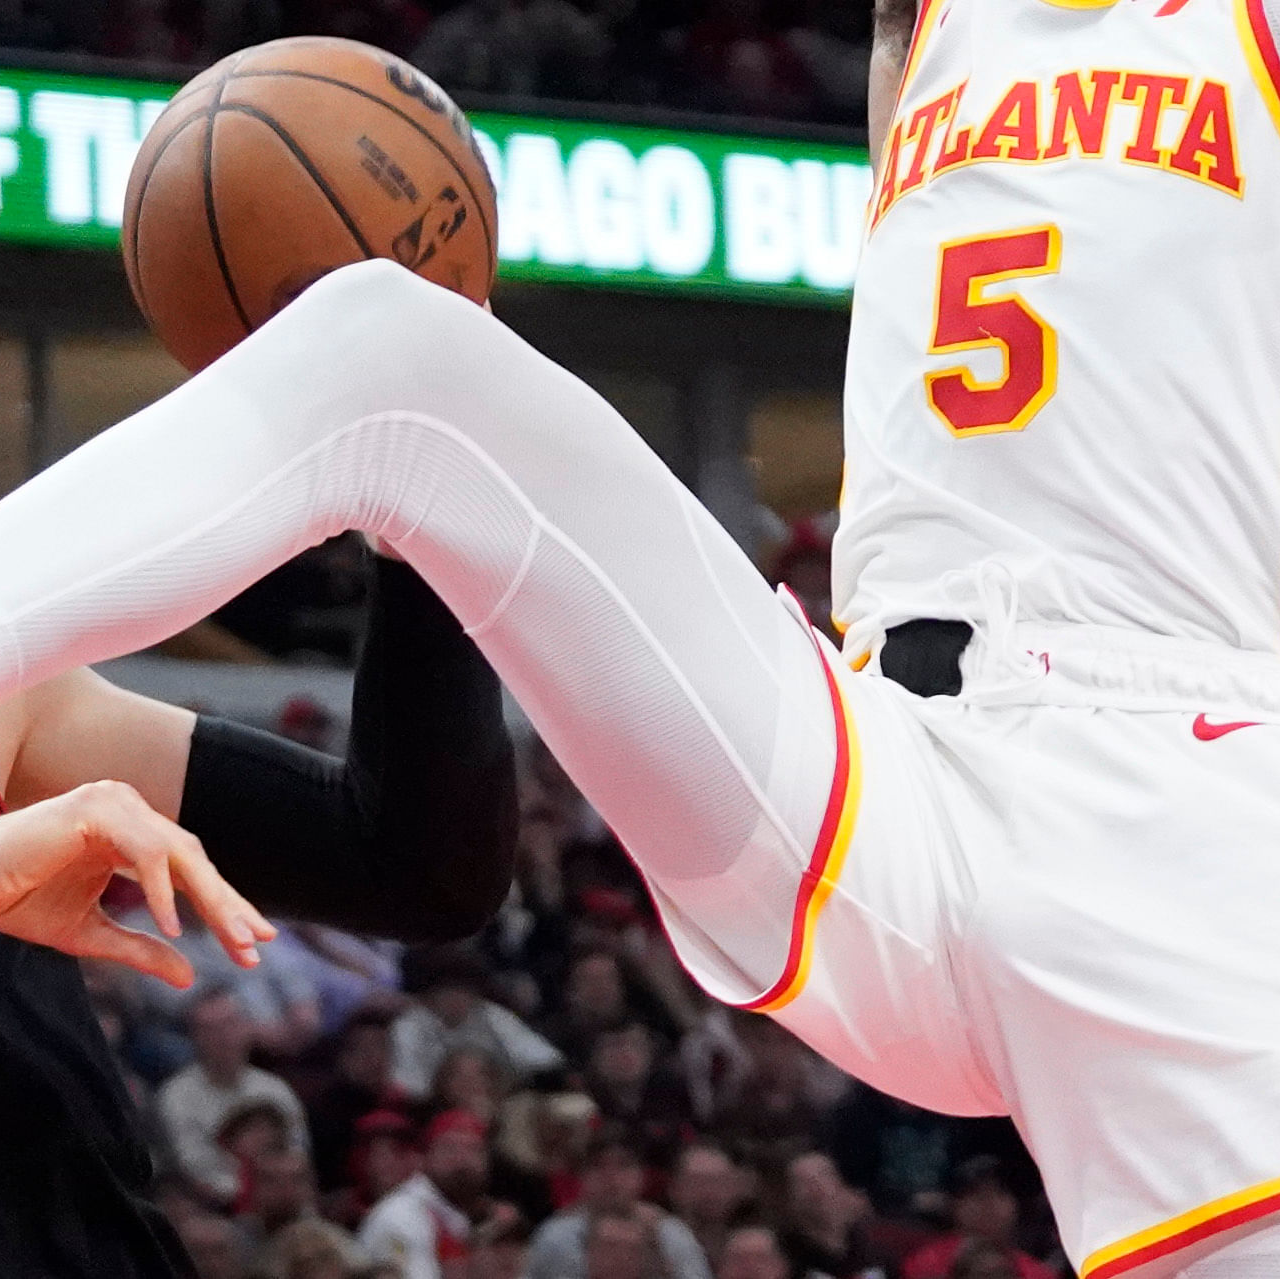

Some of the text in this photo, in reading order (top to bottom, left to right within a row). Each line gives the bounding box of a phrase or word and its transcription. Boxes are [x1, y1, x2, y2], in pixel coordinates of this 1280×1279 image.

[30, 90, 168, 226] TH
[867, 69, 1246, 241] ATLANTA
[923, 223, 1063, 439] 5
